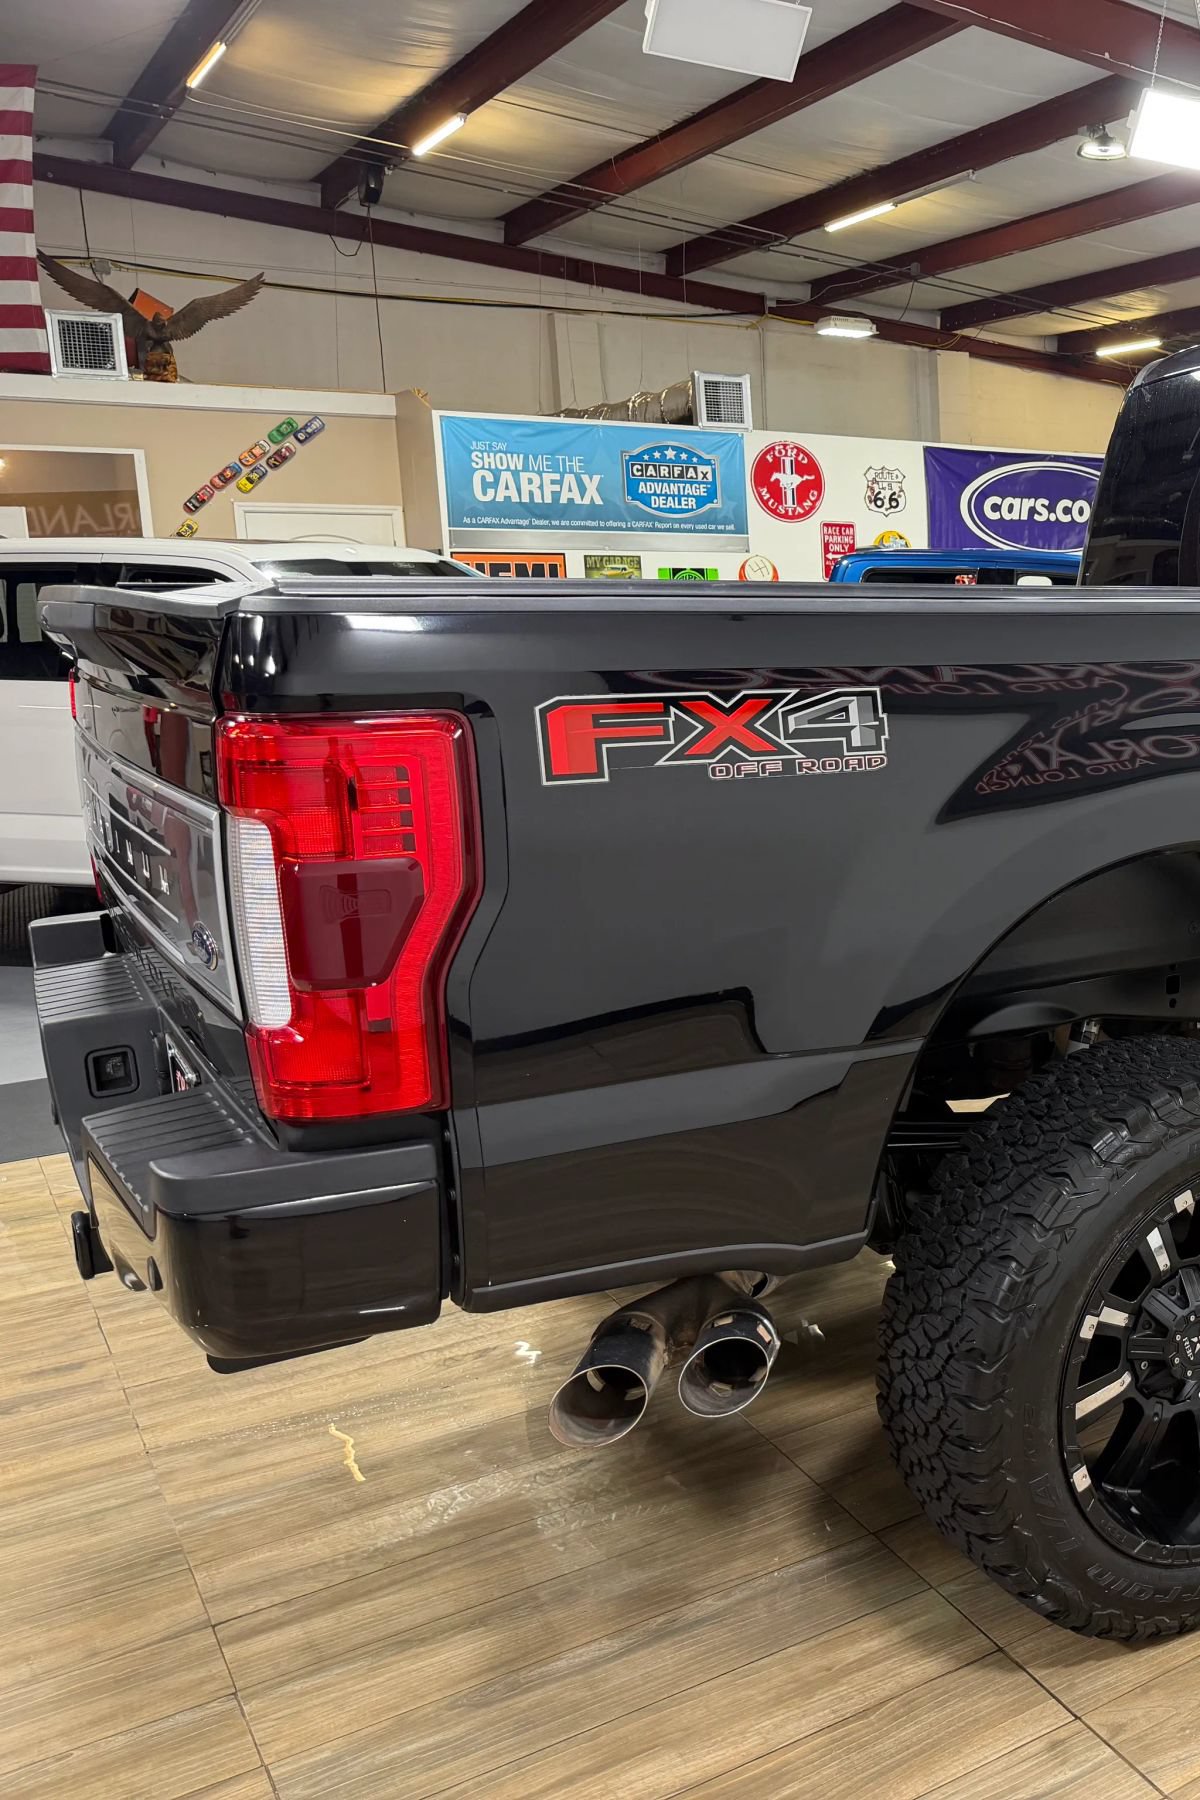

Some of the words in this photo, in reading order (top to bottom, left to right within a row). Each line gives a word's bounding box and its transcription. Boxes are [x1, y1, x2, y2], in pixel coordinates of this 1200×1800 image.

[470, 441, 490, 450] JUST
[492, 442, 507, 450] SAY
[766, 444, 808, 463] FORD
[471, 452, 524, 470] SHOW
[529, 454, 553, 471] ME
[556, 455, 585, 472] THE
[631, 463, 712, 480] CARFAX
[473, 470, 603, 504] CARFAX
[639, 482, 707, 495] ADVANTAGE
[651, 496, 696, 508] DEALER
[759, 486, 818, 516] MUSTANG
[873, 490, 900, 510] 66
[463, 516, 471, 524] As
[477, 516, 500, 524] CARFAX
[571, 519, 599, 527] committed
[606, 520, 626, 528] offering
[824, 526, 839, 534] RACE
[842, 527, 853, 535] CAR
[824, 535, 853, 544] PARKING
[829, 544, 849, 552] ONLY
[459, 561, 559, 577] EMI
[586, 556, 600, 568] MY
[603, 557, 639, 568] GARAGE
[535, 687, 888, 785] FX4
[709, 761, 782, 779] OFF
[796, 755, 887, 775] ROAD
